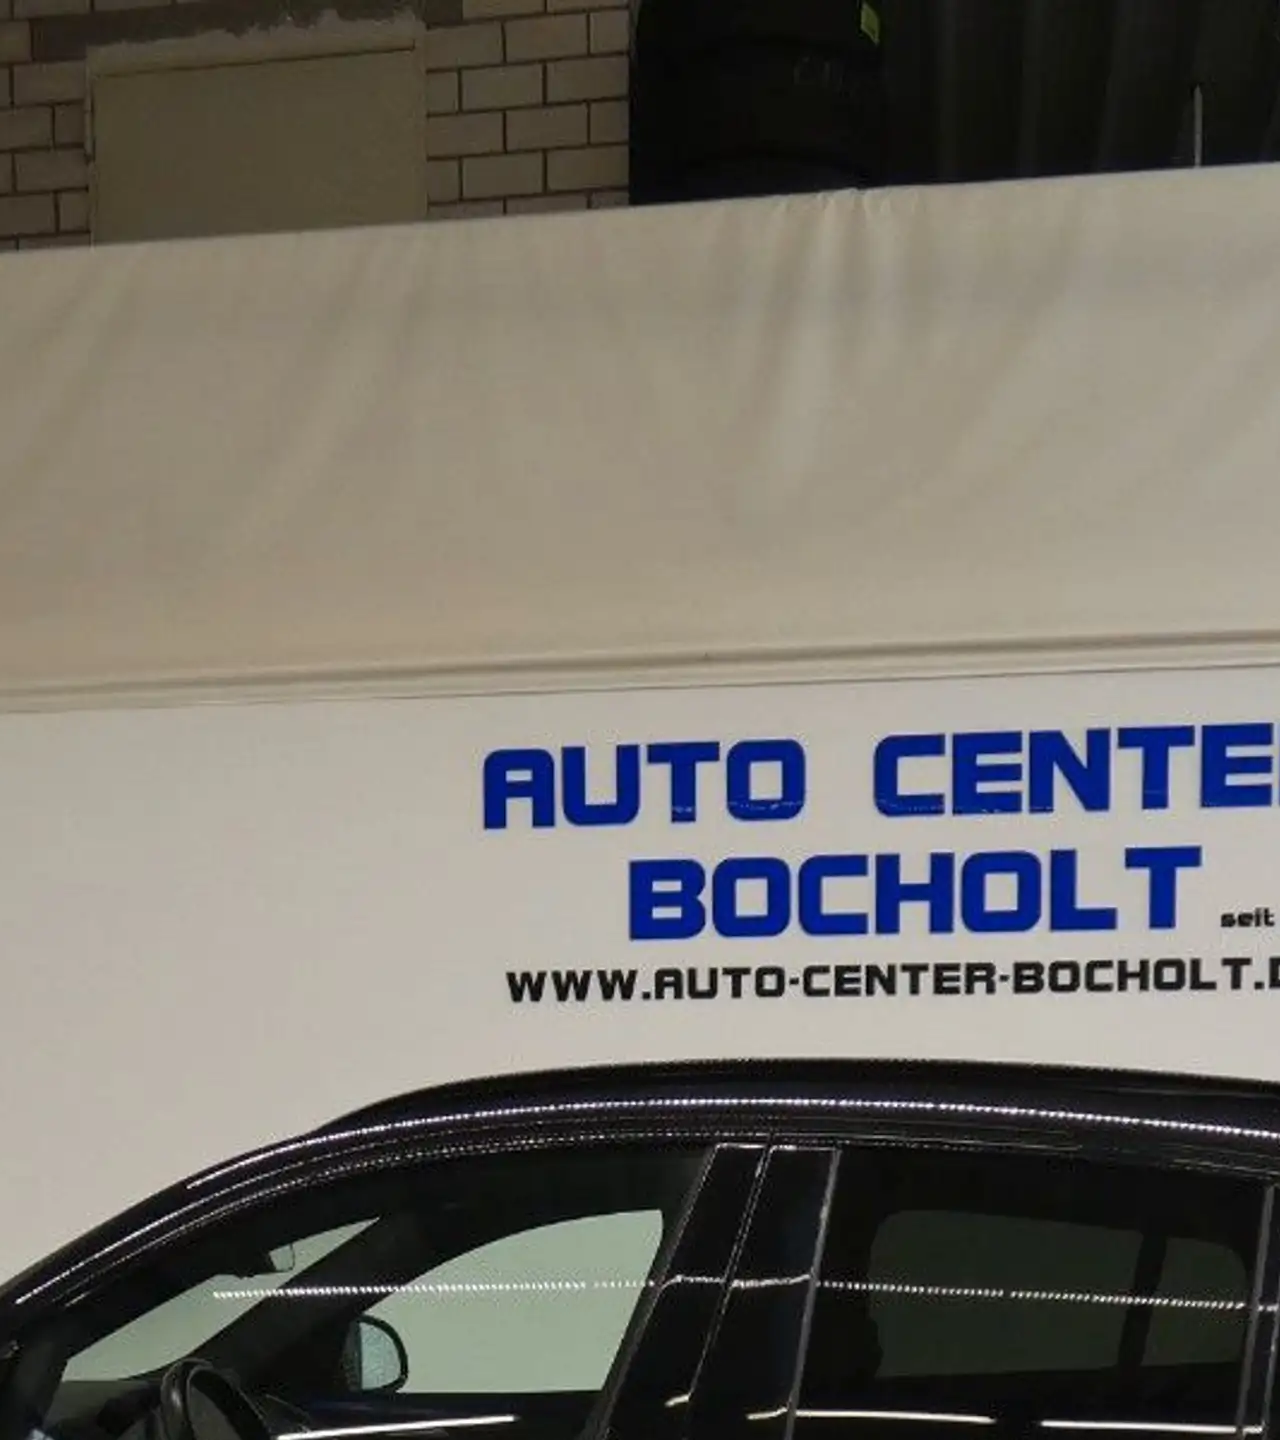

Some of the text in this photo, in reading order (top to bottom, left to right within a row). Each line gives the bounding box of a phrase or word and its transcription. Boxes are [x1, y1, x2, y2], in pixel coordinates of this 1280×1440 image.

[483, 739, 806, 830] AUTO
[628, 845, 1202, 942] BOCHOLT
[1220, 907, 1275, 928] seit
